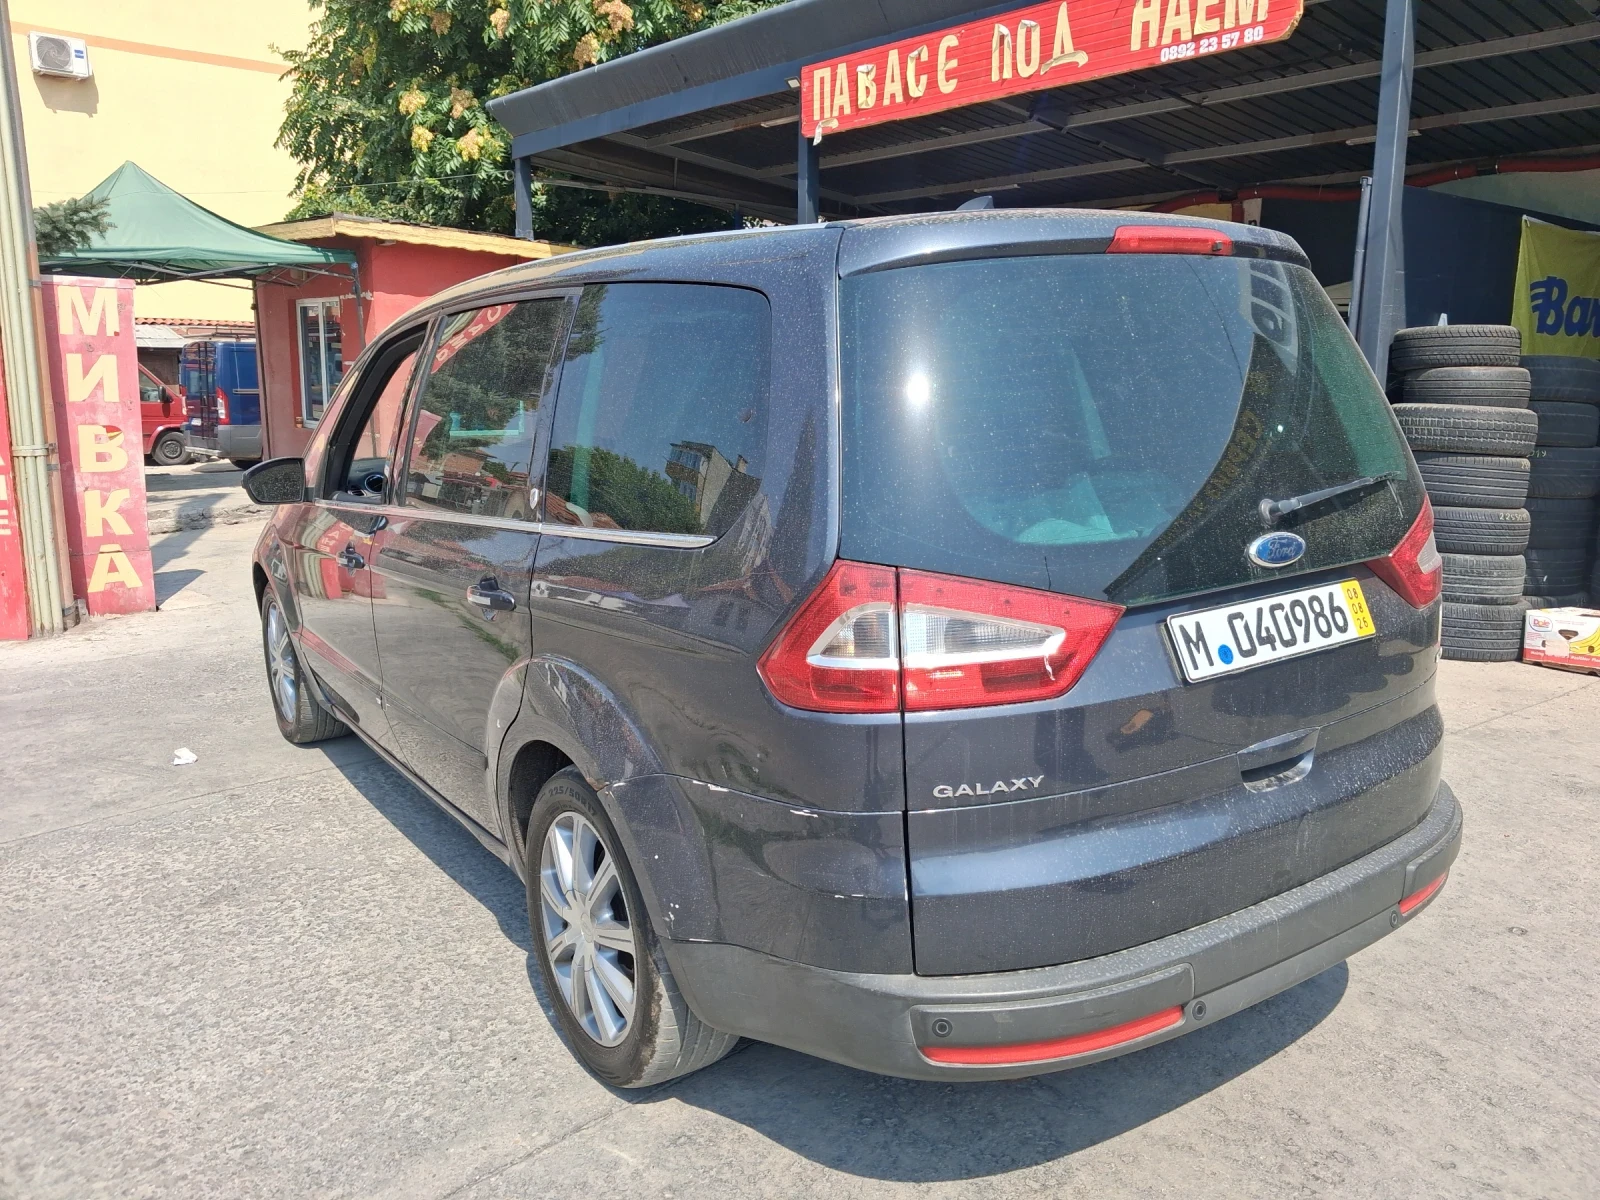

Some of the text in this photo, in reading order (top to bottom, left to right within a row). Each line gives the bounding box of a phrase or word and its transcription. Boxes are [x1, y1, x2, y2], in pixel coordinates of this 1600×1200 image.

[991, 1, 1089, 83] ПОД
[1160, 26, 1264, 62] 0892 23 57 80
[57, 285, 143, 593] МИВКА
[1266, 536, 1297, 560] Ford
[1346, 587, 1359, 600] 08
[1351, 602, 1364, 615] 08
[1179, 591, 1349, 671] M 040986
[1356, 616, 1369, 630] 26
[1533, 618, 1550, 628] Dole
[932, 775, 1045, 798] GALAXY
